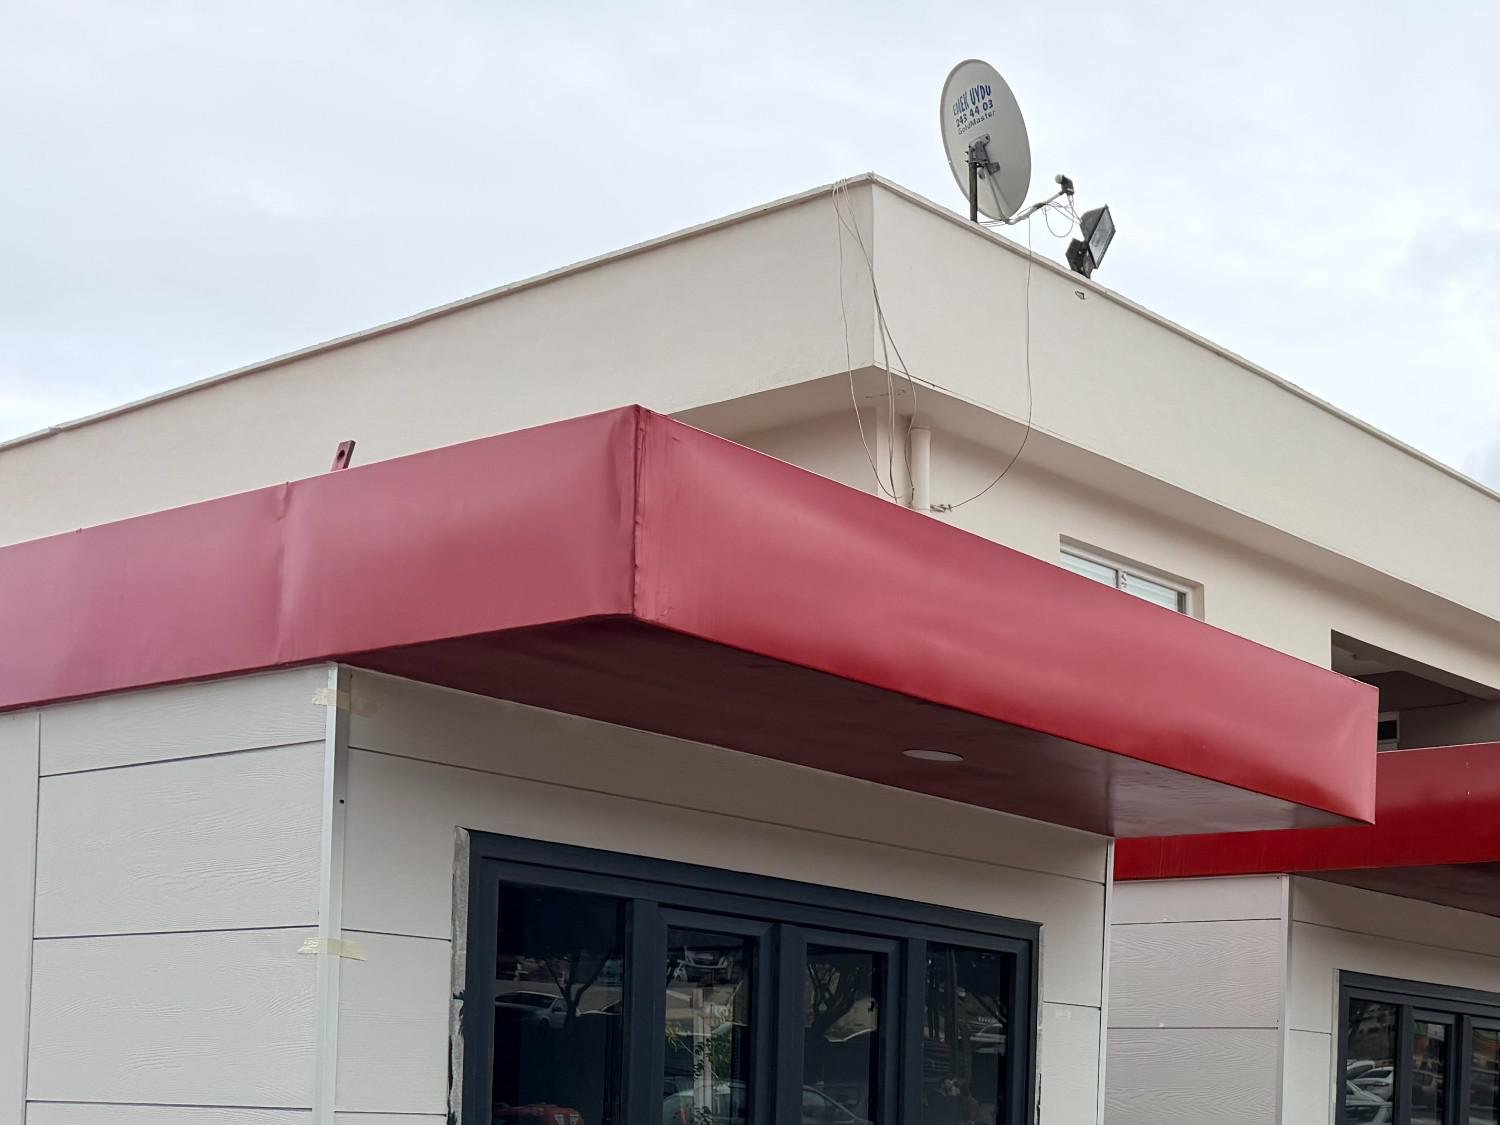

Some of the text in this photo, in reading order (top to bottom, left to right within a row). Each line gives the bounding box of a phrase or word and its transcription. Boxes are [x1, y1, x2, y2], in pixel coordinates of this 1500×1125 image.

[969, 84, 992, 106] UYDU
[969, 105, 980, 118] 44
[982, 99, 994, 111] 03
